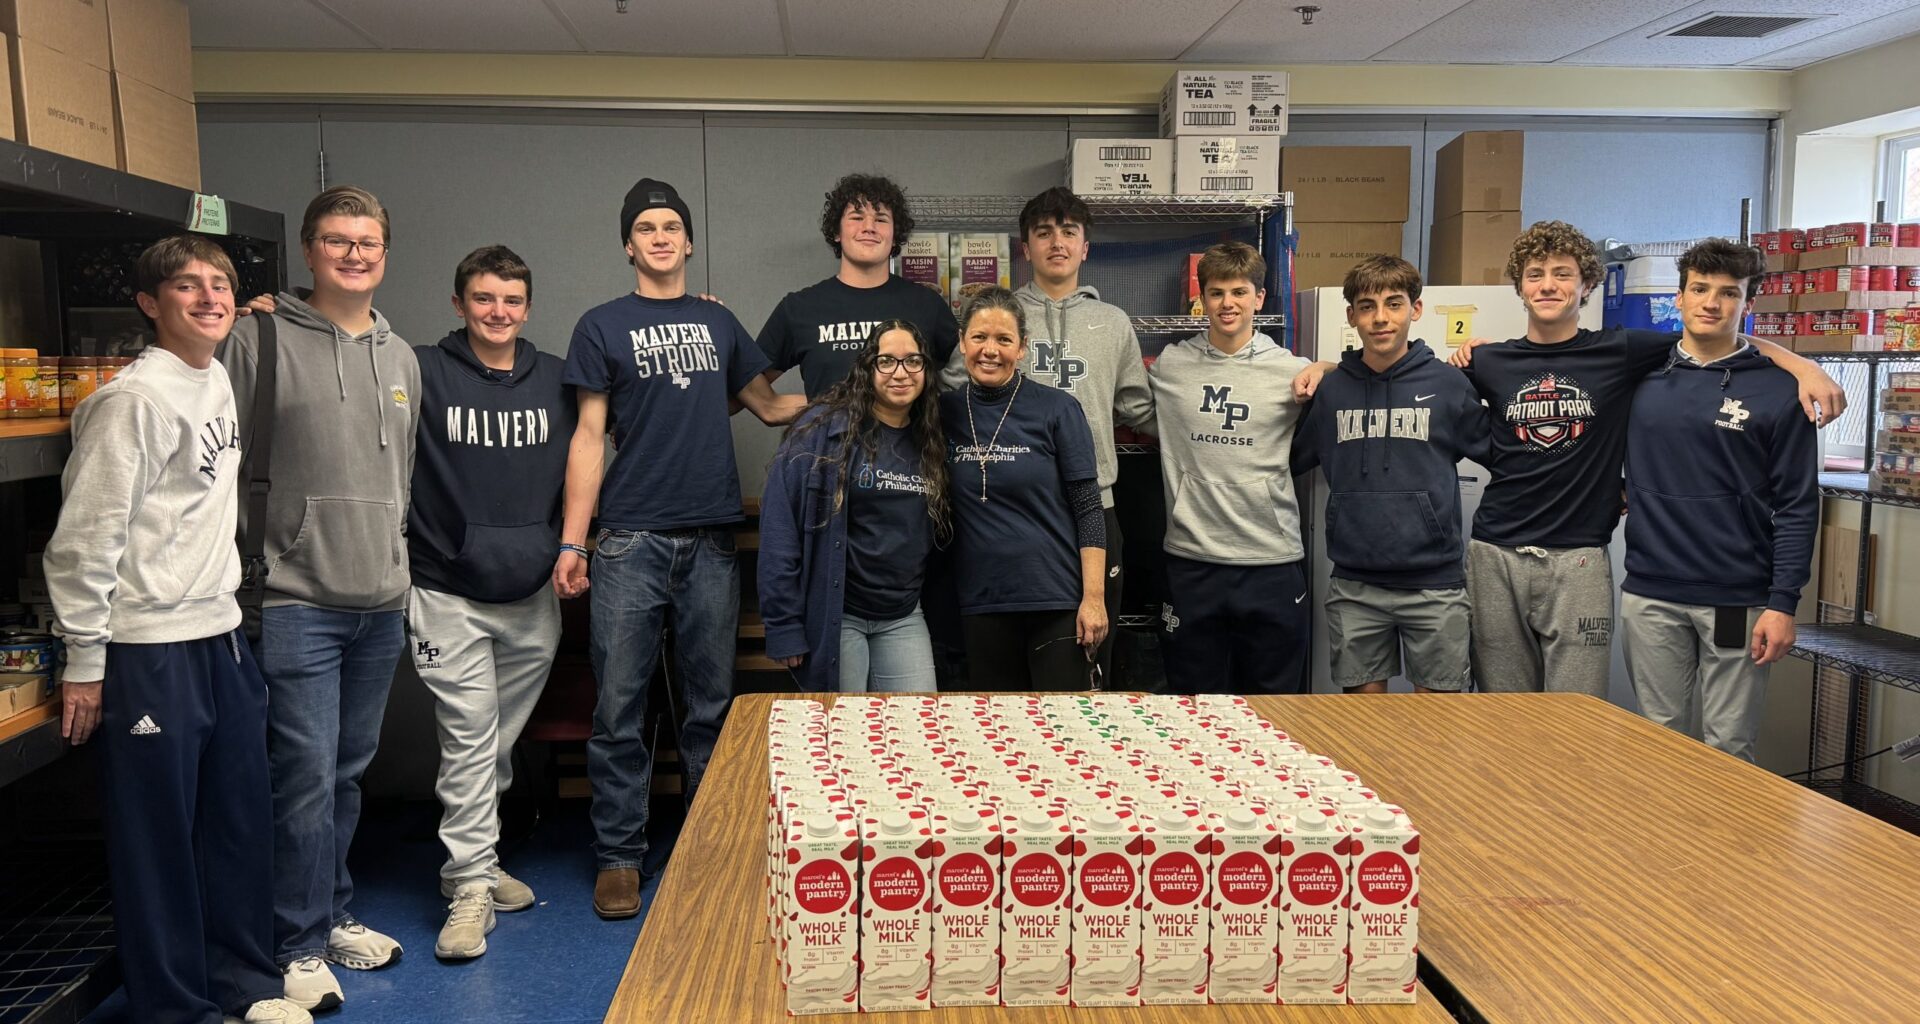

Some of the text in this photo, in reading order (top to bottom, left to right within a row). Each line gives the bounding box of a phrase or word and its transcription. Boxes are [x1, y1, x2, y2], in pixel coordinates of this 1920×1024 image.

[1185, 89, 1214, 98] TEA
[1121, 173, 1149, 183] TEA
[907, 240, 922, 248] bowl
[967, 240, 983, 248] bowl
[907, 247, 931, 255] basket
[967, 247, 992, 255] basket
[966, 258, 993, 266] RAISIN
[1455, 321, 1464, 334] 2
[629, 323, 712, 351] MALVERN
[634, 344, 719, 378] STRONG
[1031, 339, 1089, 392] MP
[671, 372, 691, 389] MP
[1198, 384, 1251, 432] MP
[1506, 400, 1595, 421] PATRIOT PARK
[1720, 396, 1750, 423] MP
[447, 406, 549, 447] MALVERN
[1336, 408, 1430, 443] MALVERN
[1190, 433, 1254, 446] LACROSSE
[990, 444, 1031, 453] Charities
[876, 469, 911, 482] Catholic
[876, 480, 933, 497] of Philadelph
[417, 640, 440, 662] MP
[130, 726, 161, 735] adidas
[874, 878, 918, 887] modern
[944, 874, 987, 882] modern
[1015, 874, 1058, 882] modern
[1085, 874, 1128, 882] modern
[1154, 873, 1197, 881] modern
[1223, 873, 1266, 881] modern
[1293, 873, 1336, 882] modern
[1362, 873, 1405, 881] modern
[799, 880, 844, 889] modern
[943, 915, 989, 925] WHOLE
[1014, 915, 1060, 926] WHOLE
[1084, 915, 1130, 926] WHOLE
[1153, 913, 1198, 925] WHOLE
[1222, 913, 1267, 924] WHOLE
[1291, 914, 1337, 925] WHOLE
[1361, 913, 1407, 924] WHOLE
[799, 922, 846, 934] WHOLE
[873, 919, 920, 930] WHOLE
[949, 927, 984, 938] MILK
[1020, 927, 1055, 938] MILK
[1090, 927, 1125, 938] MILK
[1159, 926, 1193, 937] MILK
[1228, 925, 1262, 936] MILK
[1297, 926, 1332, 937] MILK
[1367, 925, 1402, 936] MILK
[805, 934, 841, 946] MILK
[879, 932, 914, 943] MILK
